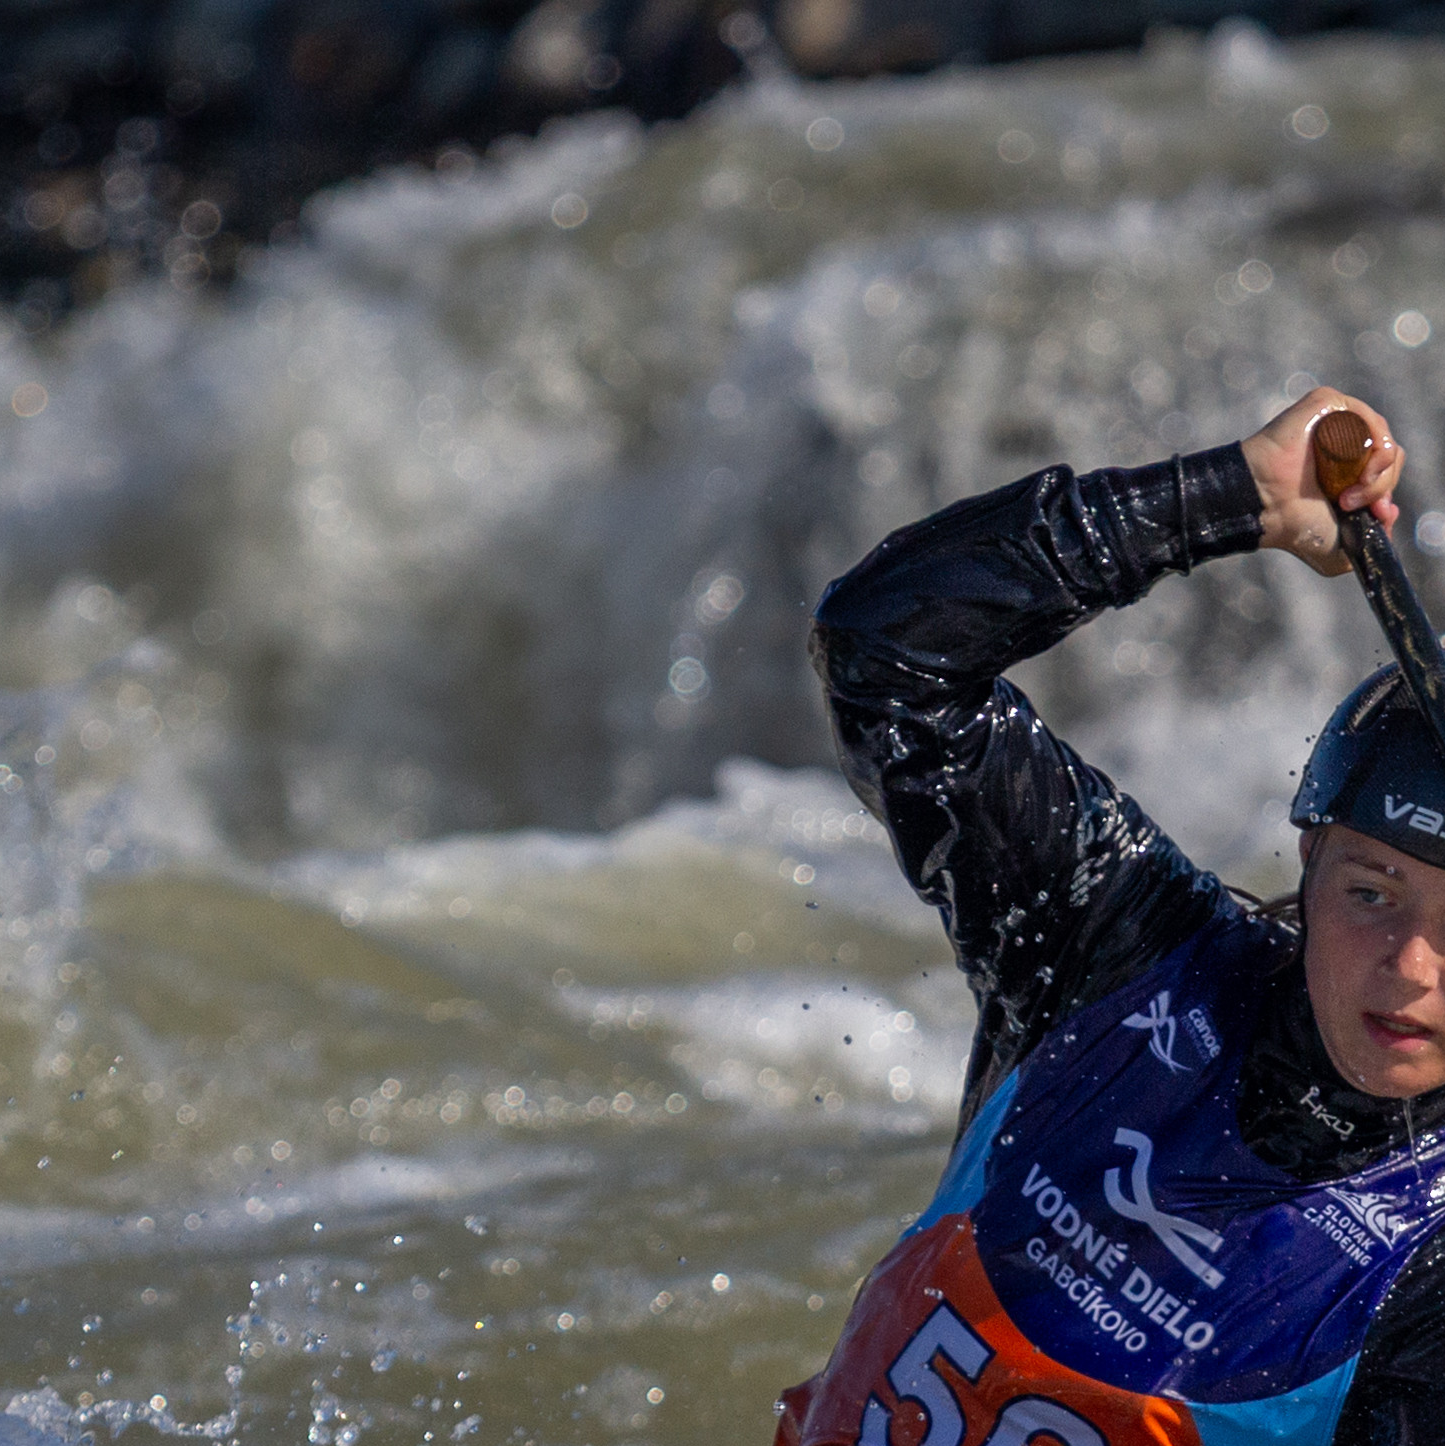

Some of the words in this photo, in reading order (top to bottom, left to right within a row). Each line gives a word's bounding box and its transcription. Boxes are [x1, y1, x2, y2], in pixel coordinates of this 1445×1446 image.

[1188, 1008, 1222, 1059] canoe
[1020, 1162, 1129, 1280] VODNÉ
[1120, 1266, 1216, 1351] DIELO
[1302, 1206, 1373, 1267] CANOEING
[1322, 1203, 1376, 1252] SLOVAK
[1025, 1236, 1148, 1353] GABČÍKOVO
